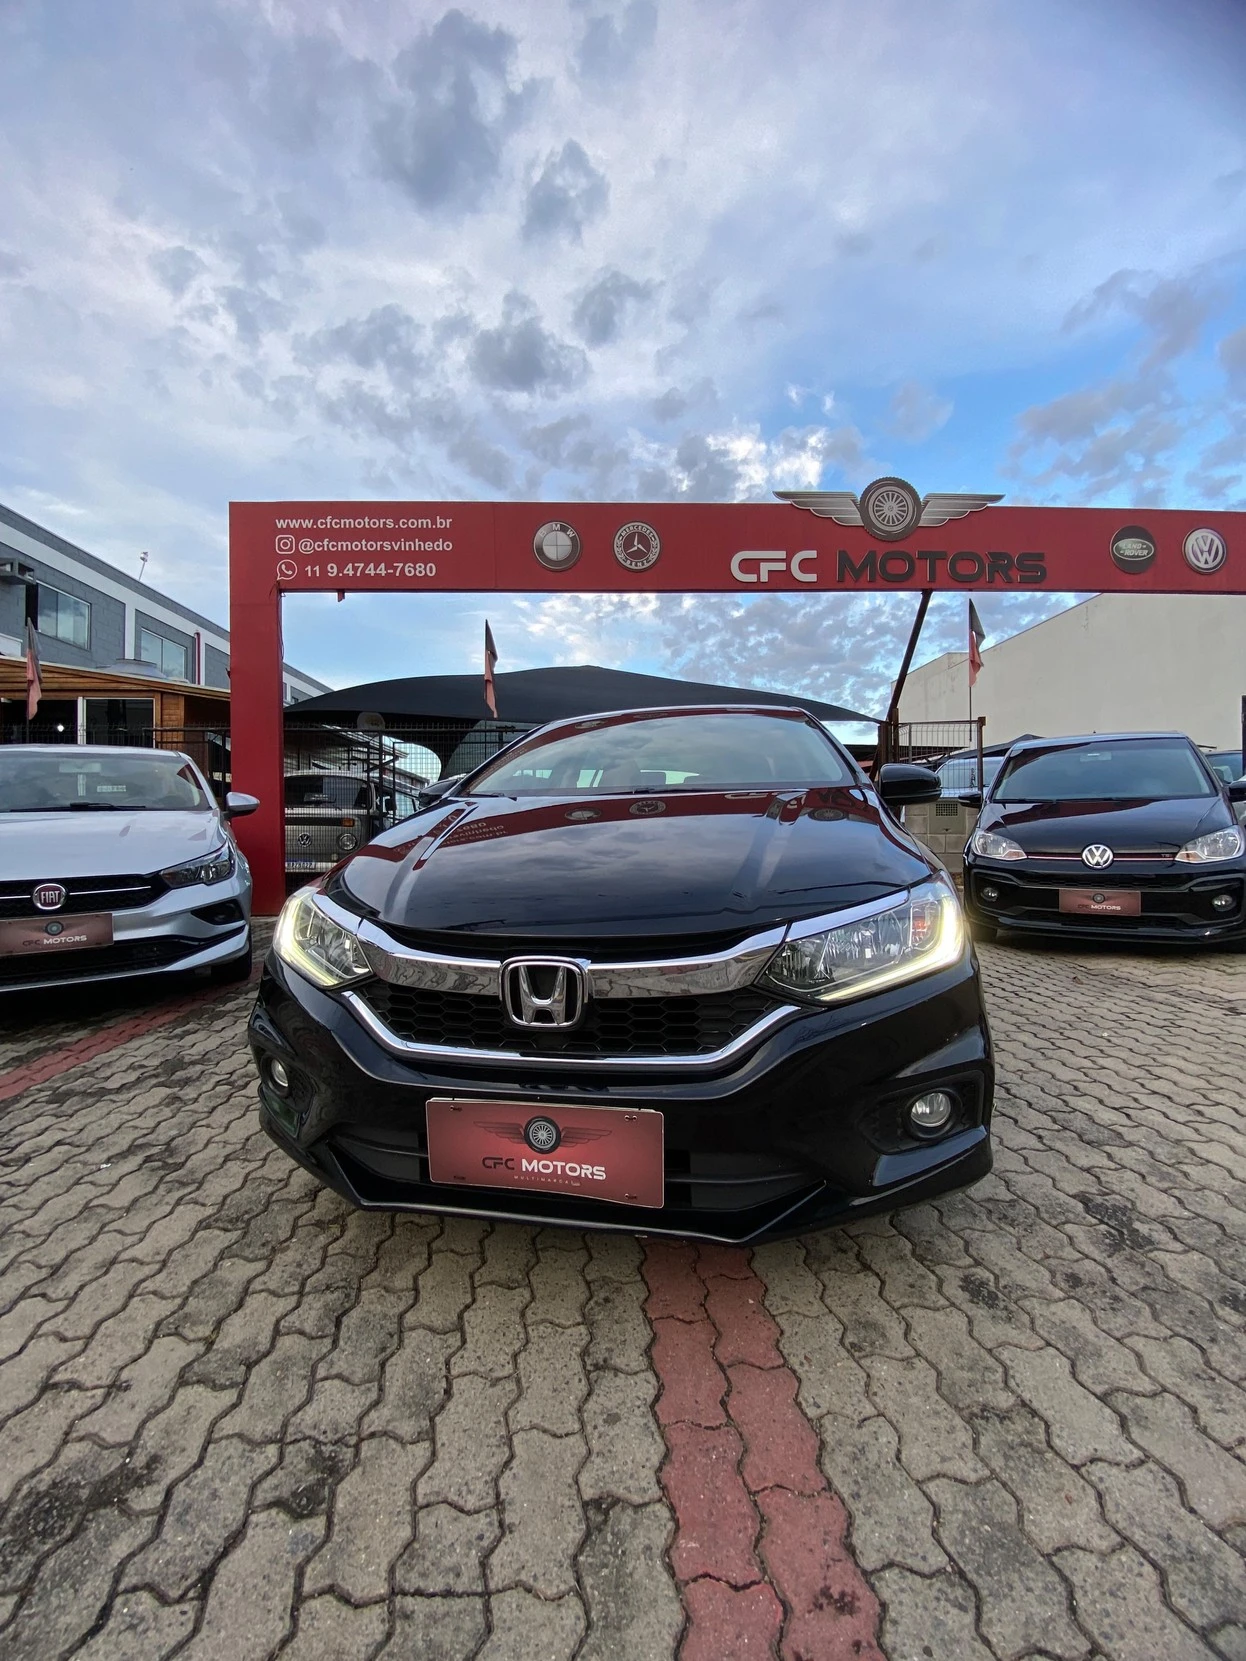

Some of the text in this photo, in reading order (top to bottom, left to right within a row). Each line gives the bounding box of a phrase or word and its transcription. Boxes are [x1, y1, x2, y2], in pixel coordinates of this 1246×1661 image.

[275, 515, 453, 529] www.cfcmotors.com.br
[539, 523, 576, 538] BMW
[298, 538, 453, 554] @cfcmotorsvinhedo
[304, 562, 437, 577] 11 9.4744-7680
[730, 550, 1048, 583] CFC MOTORS
[41, 890, 60, 904] FIAT
[43, 934, 88, 945] MOTORS
[482, 1156, 607, 1181] CFC MOTORS
